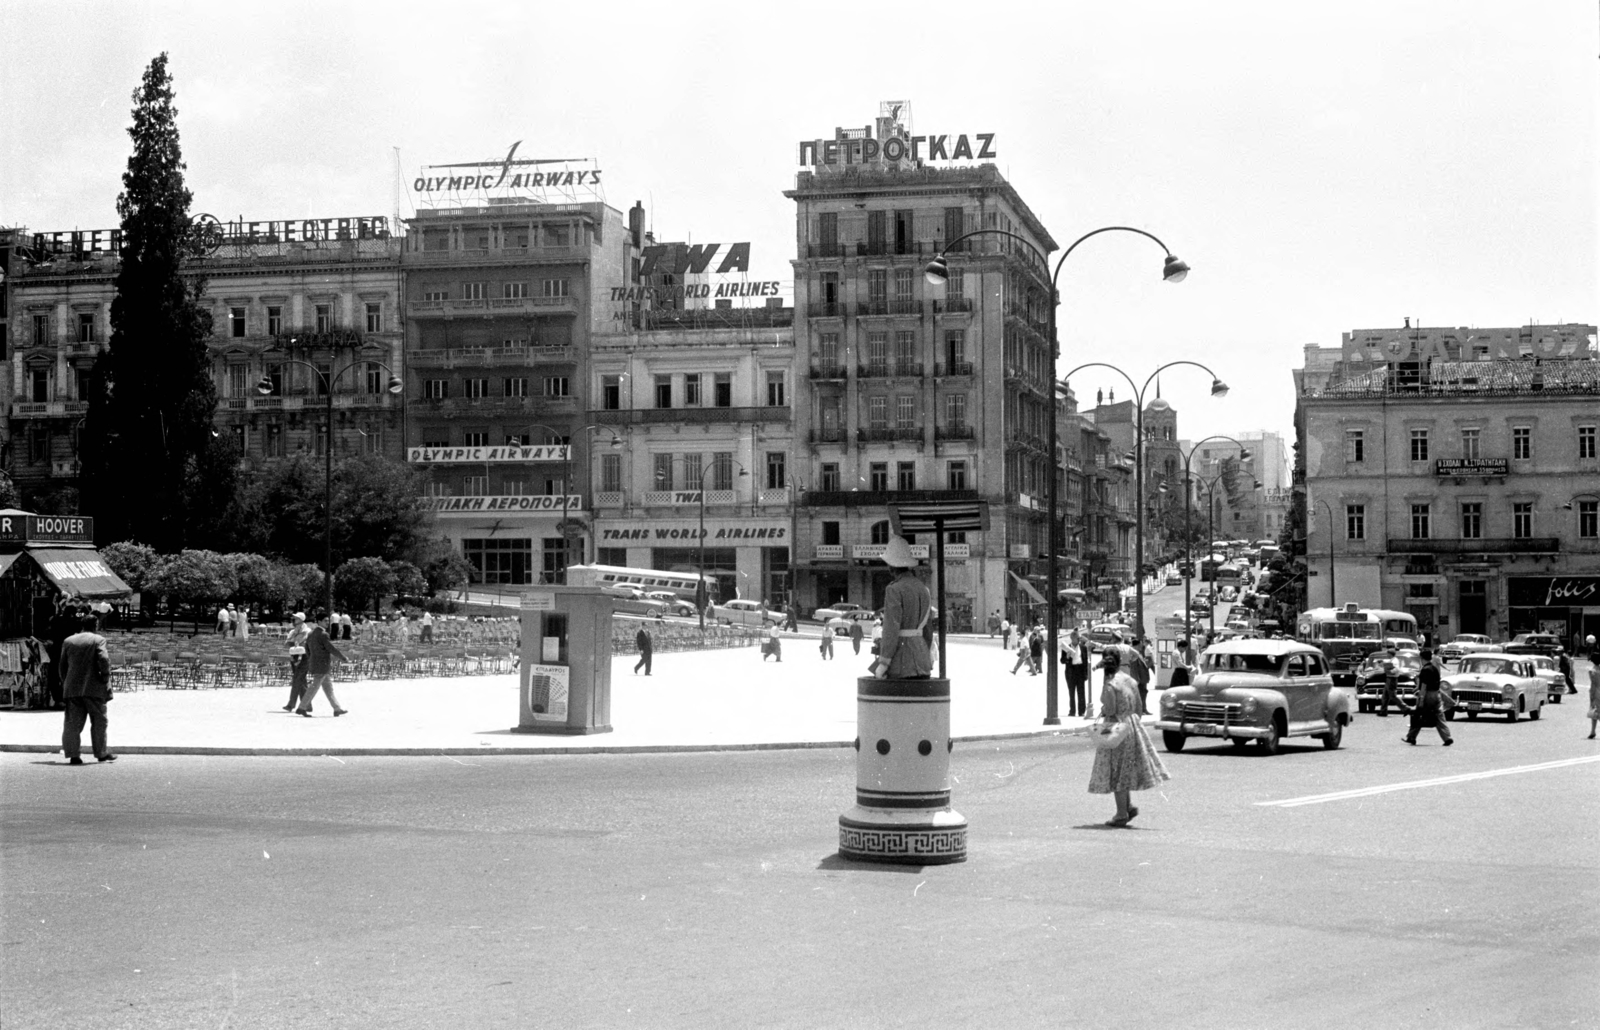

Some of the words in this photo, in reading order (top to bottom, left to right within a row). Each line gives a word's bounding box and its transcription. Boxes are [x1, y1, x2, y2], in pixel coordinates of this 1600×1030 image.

[414, 175, 494, 192] OLYMPIC
[510, 170, 602, 188] AIRWAYS
[640, 242, 750, 276] TWA
[610, 286, 653, 301] TRANS
[661, 283, 710, 299] WORLD
[715, 281, 780, 298] AIRLINES
[411, 448, 482, 461] OLYMPIC
[488, 446, 567, 460] AIRWAYS
[675, 492, 702, 503] TWA
[36, 517, 84, 534] HOOVER
[603, 529, 649, 540] TRANS
[655, 528, 708, 539] WORLD
[715, 527, 786, 539] AIRLINES
